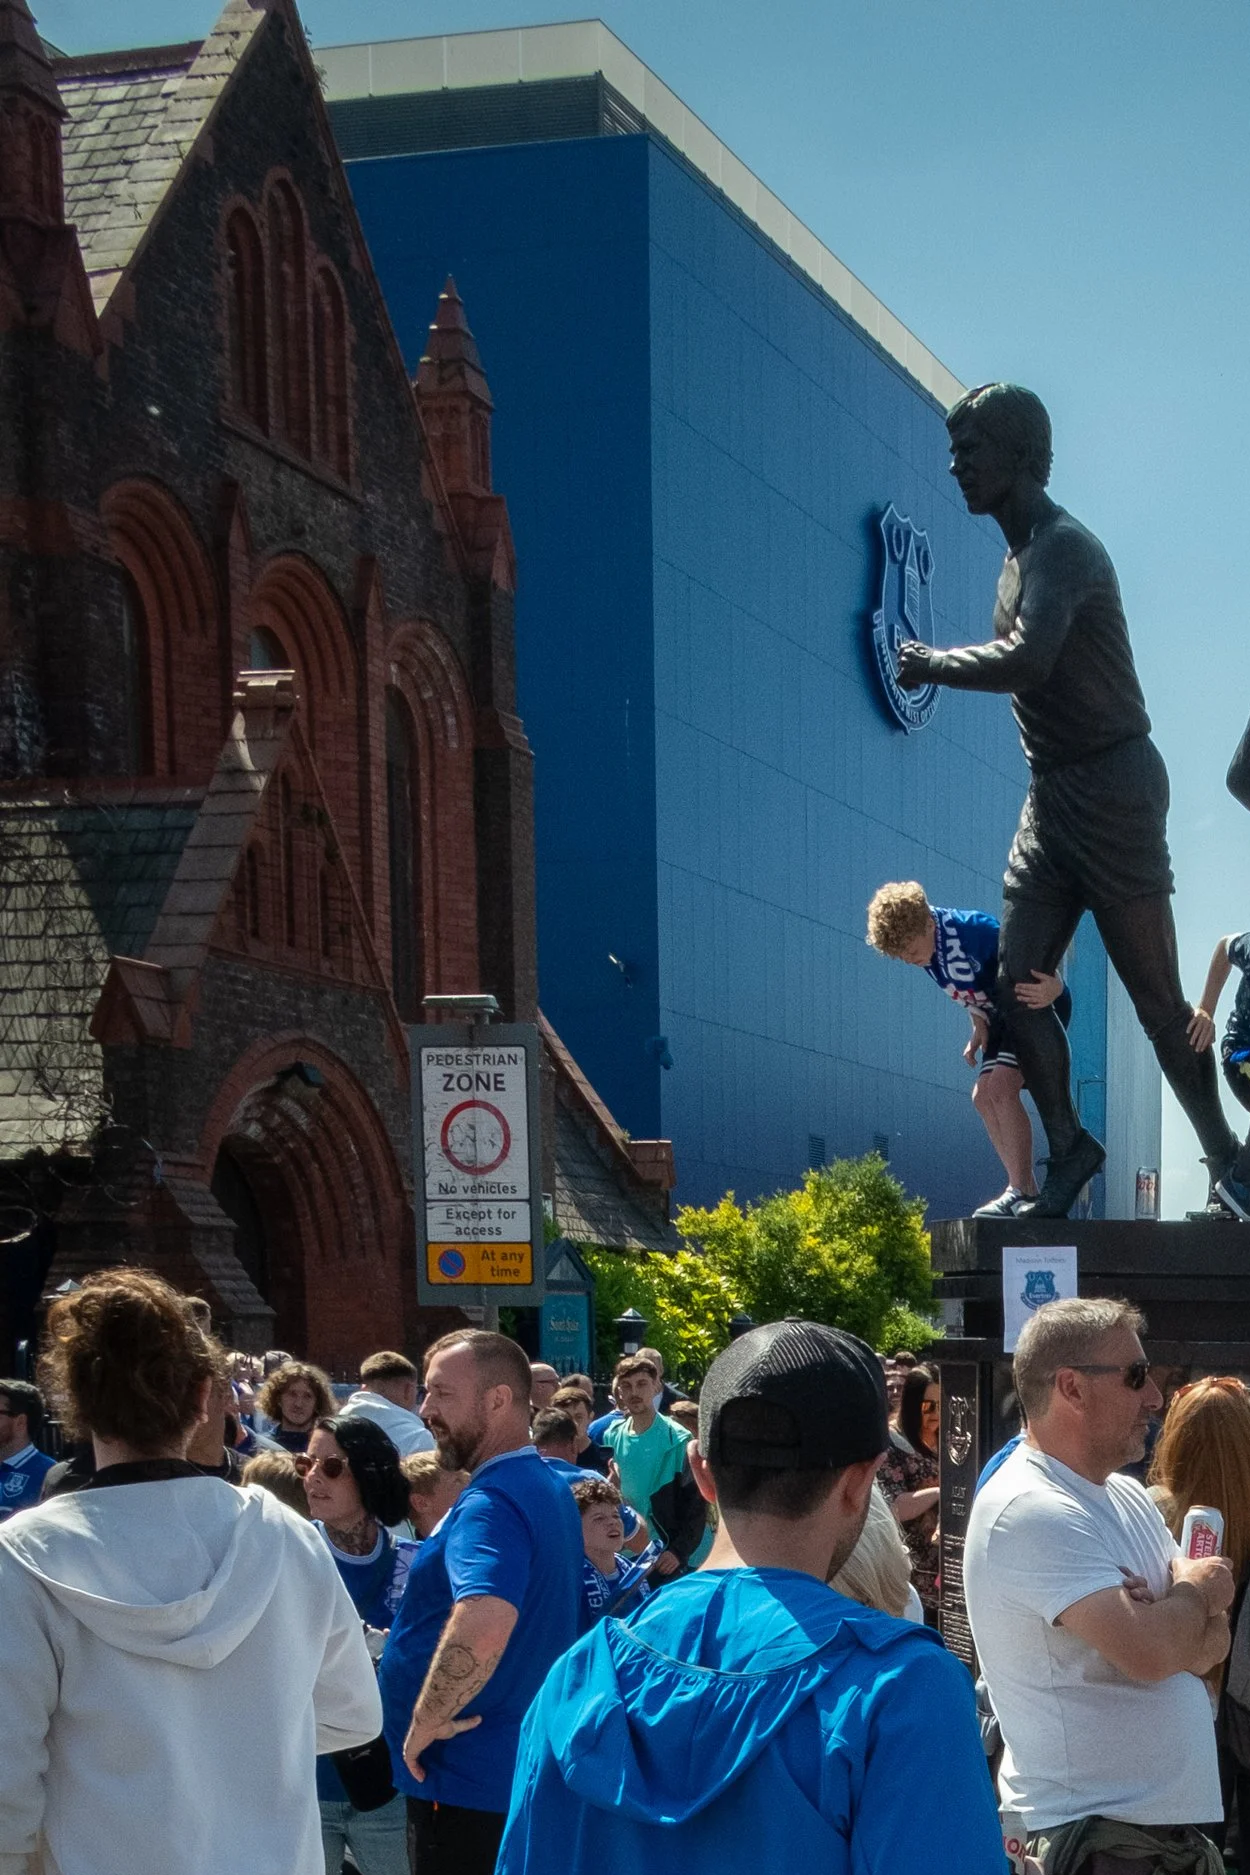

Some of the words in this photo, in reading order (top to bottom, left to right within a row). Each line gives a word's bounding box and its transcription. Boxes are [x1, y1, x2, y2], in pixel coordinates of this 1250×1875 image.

[426, 1053, 518, 1066] PEDESTRIAN
[442, 1073, 506, 1092] ZONE
[438, 1182, 457, 1195] No
[462, 1181, 518, 1194] vehicles
[446, 1207, 493, 1222] Except
[497, 1207, 517, 1220] for
[455, 1226, 503, 1236] access
[481, 1249, 496, 1261] At
[500, 1251, 525, 1263] any
[490, 1266, 520, 1277] time
